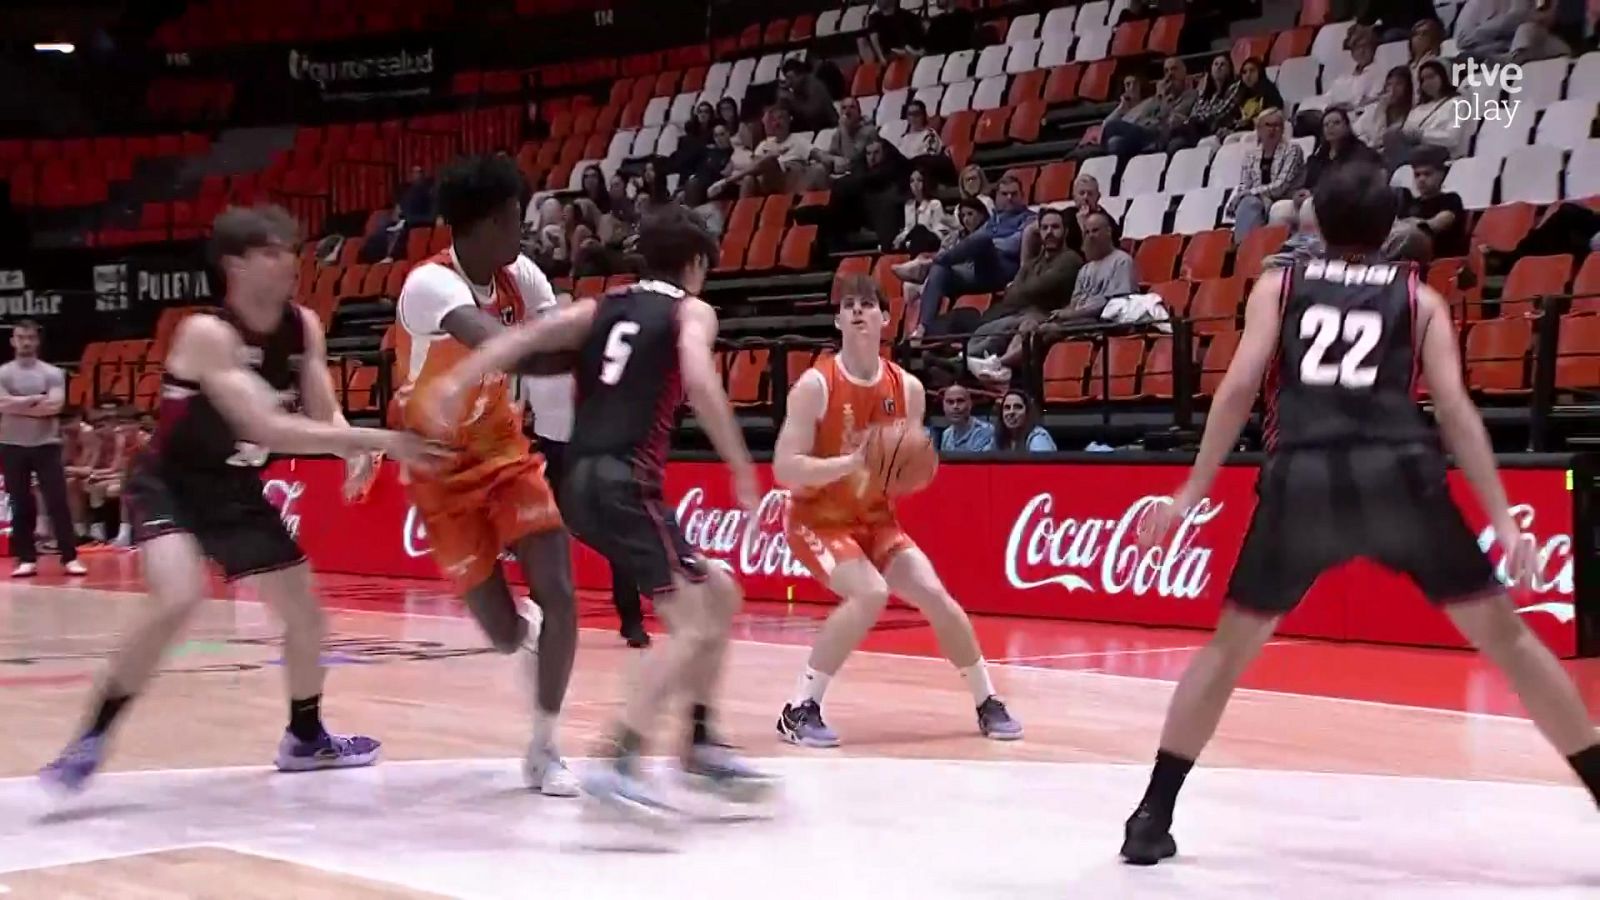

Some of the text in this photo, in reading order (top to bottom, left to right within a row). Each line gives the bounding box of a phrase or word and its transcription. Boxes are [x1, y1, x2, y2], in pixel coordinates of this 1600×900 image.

[600, 320, 641, 385] 5
[1299, 303, 1383, 388] 22
[1005, 492, 1224, 598] Coca-Cola
